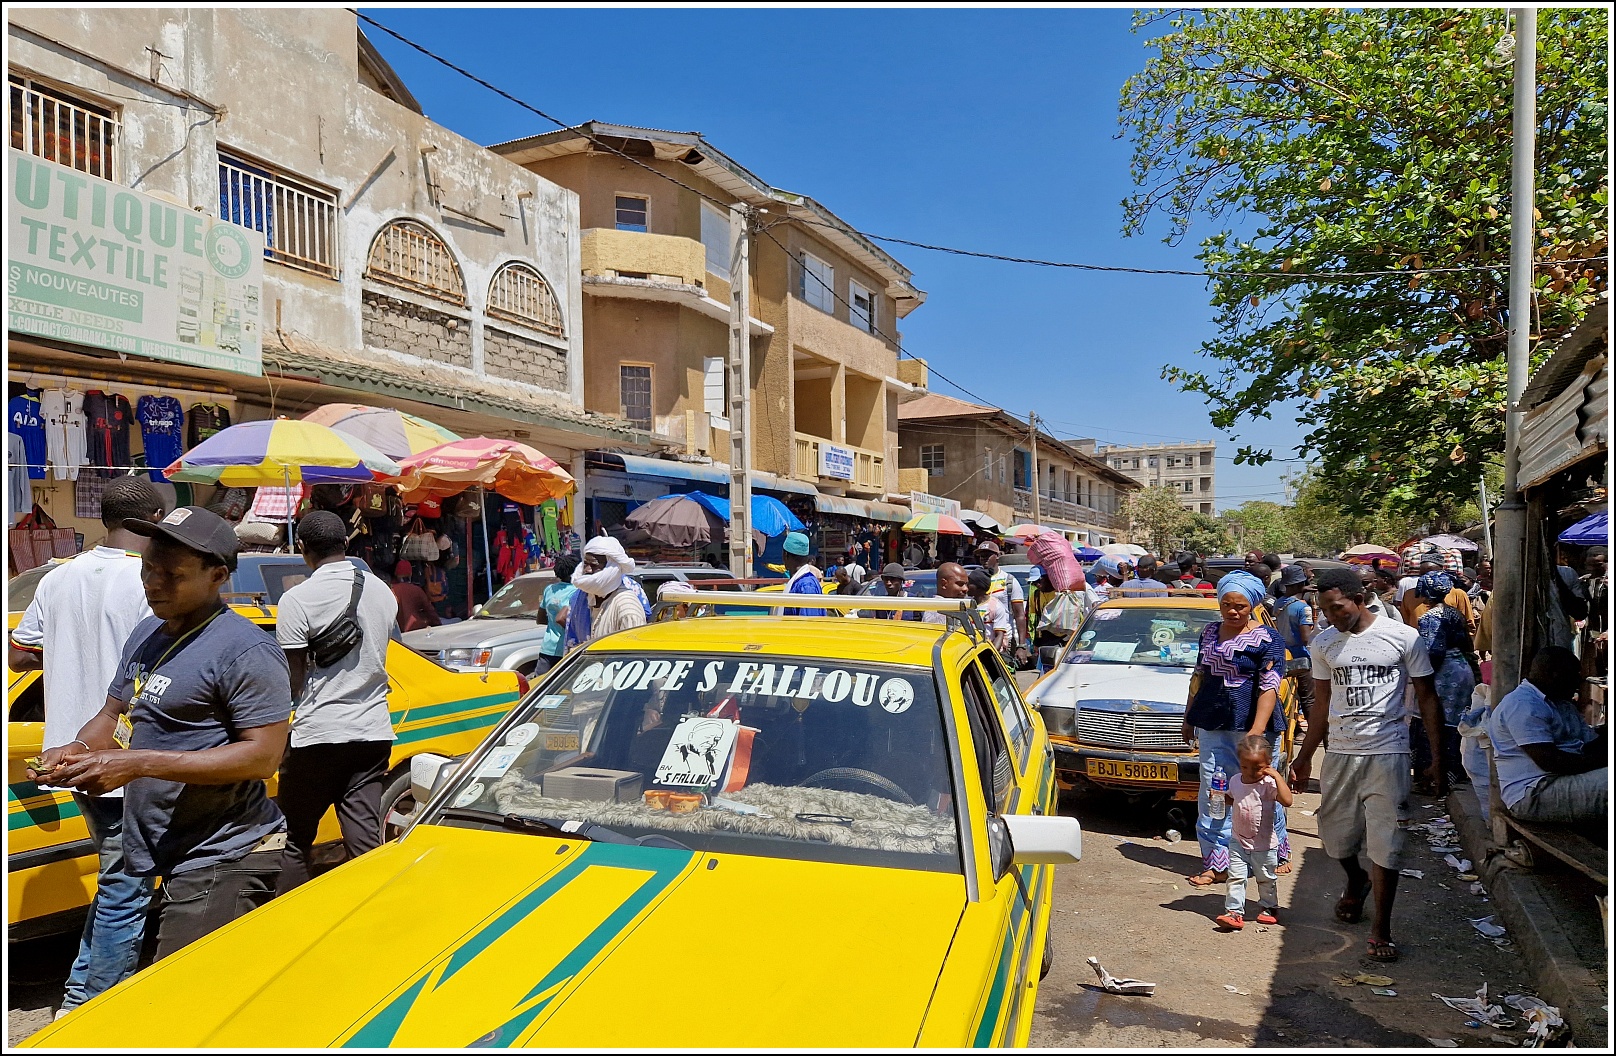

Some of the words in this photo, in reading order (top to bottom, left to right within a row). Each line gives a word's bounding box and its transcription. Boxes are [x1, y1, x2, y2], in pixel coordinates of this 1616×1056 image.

[15, 158, 204, 257] UTIQUE
[20, 216, 168, 289] TEXTILE
[26, 269, 139, 308] NOUVEAUTES
[69, 309, 124, 332] NEEDS
[592, 660, 694, 692] SOPE
[696, 661, 724, 692] S
[726, 662, 880, 707] FALLOU
[1333, 665, 1354, 686] NEW
[1358, 664, 1399, 684] YORK
[1346, 686, 1376, 707] CITY
[672, 773, 711, 784] FALLOU
[1098, 761, 1122, 777] BJL
[1124, 764, 1158, 779] 5808
[1160, 765, 1169, 779] R
